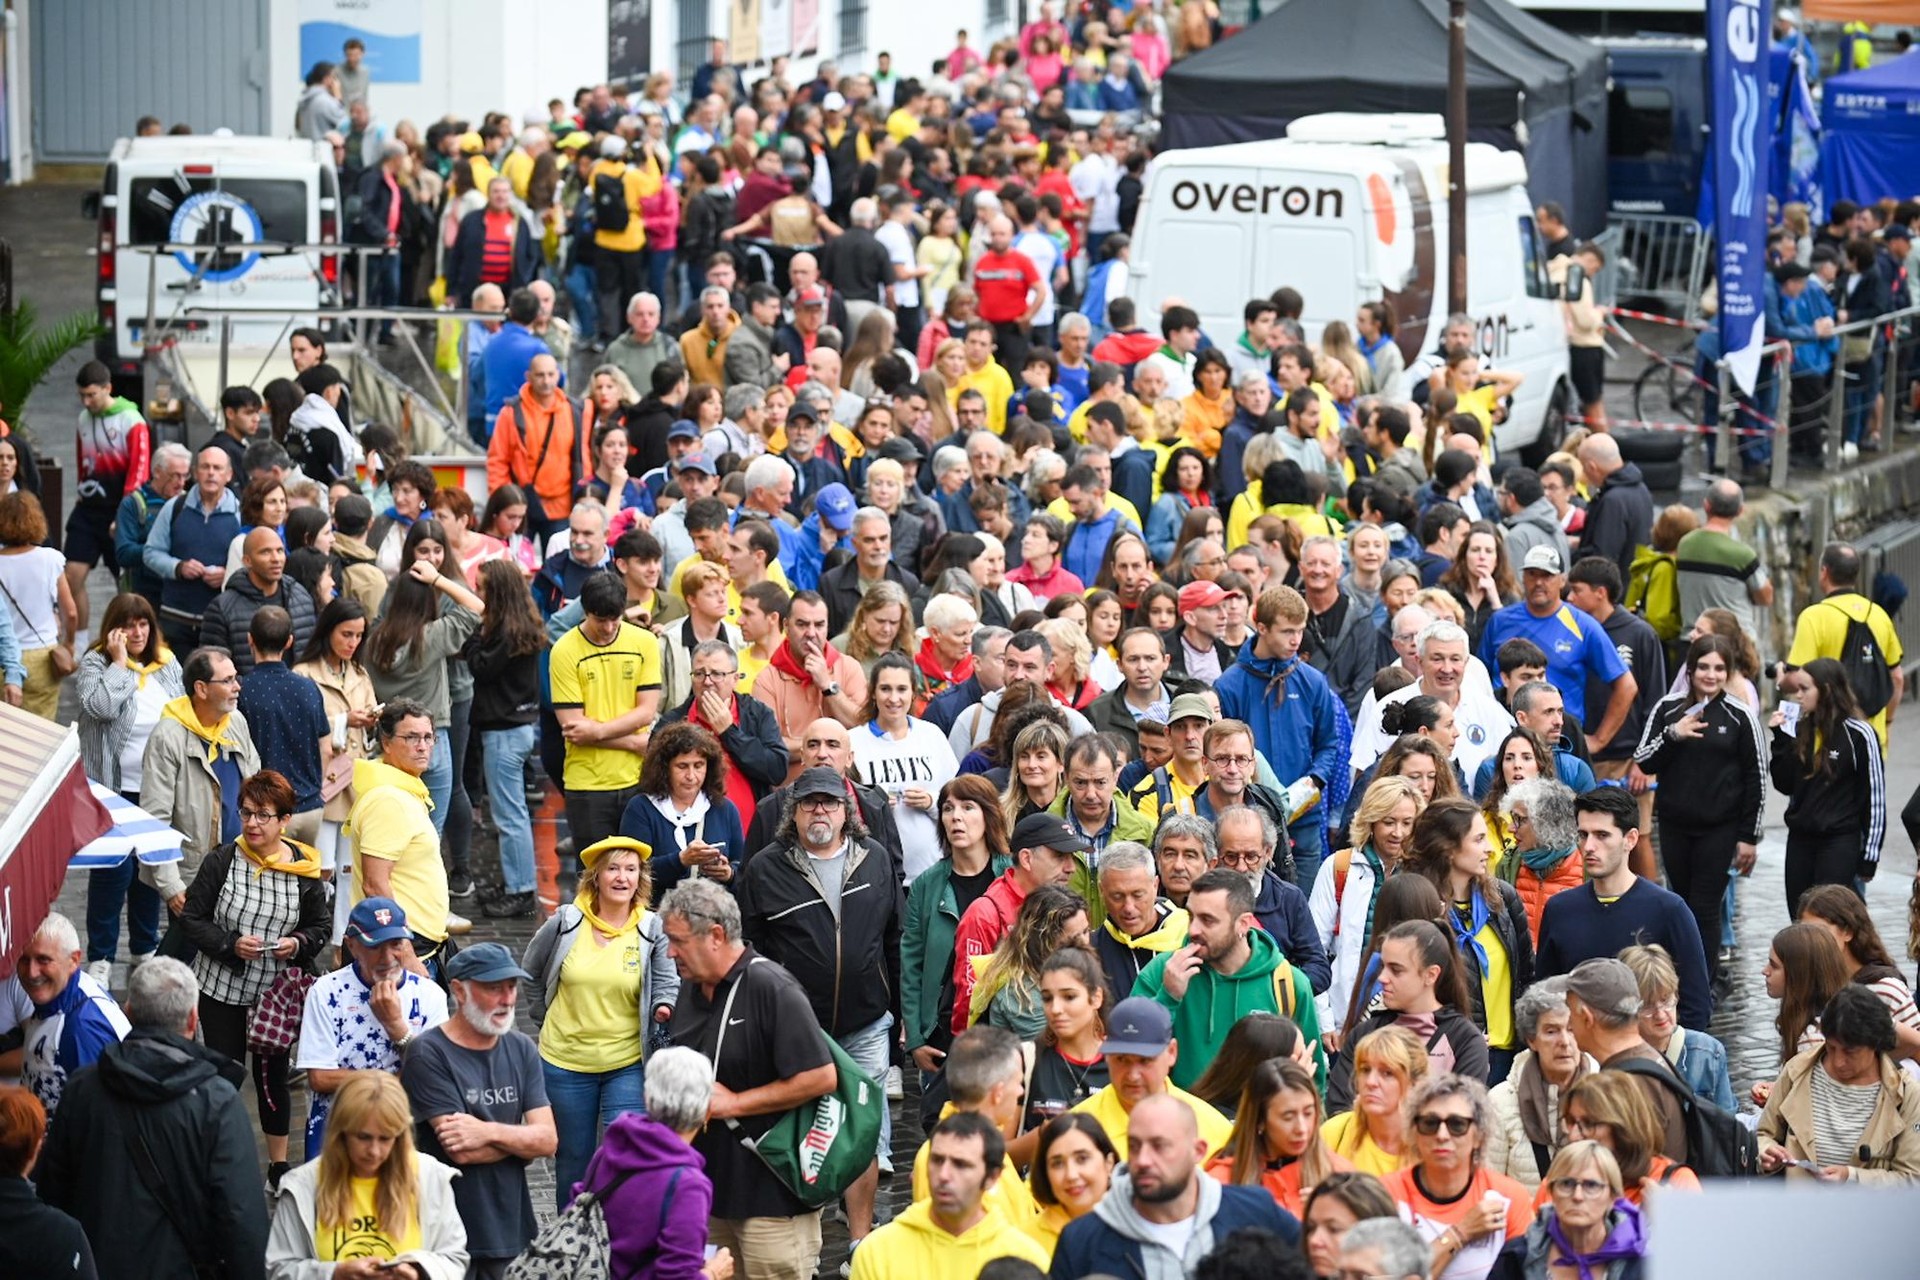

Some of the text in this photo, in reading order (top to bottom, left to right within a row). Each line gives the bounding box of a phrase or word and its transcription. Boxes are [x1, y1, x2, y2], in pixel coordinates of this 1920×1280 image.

[1172, 181, 1343, 218] overon
[868, 755, 934, 785] LEVI'S
[805, 1092, 835, 1151] Migue
